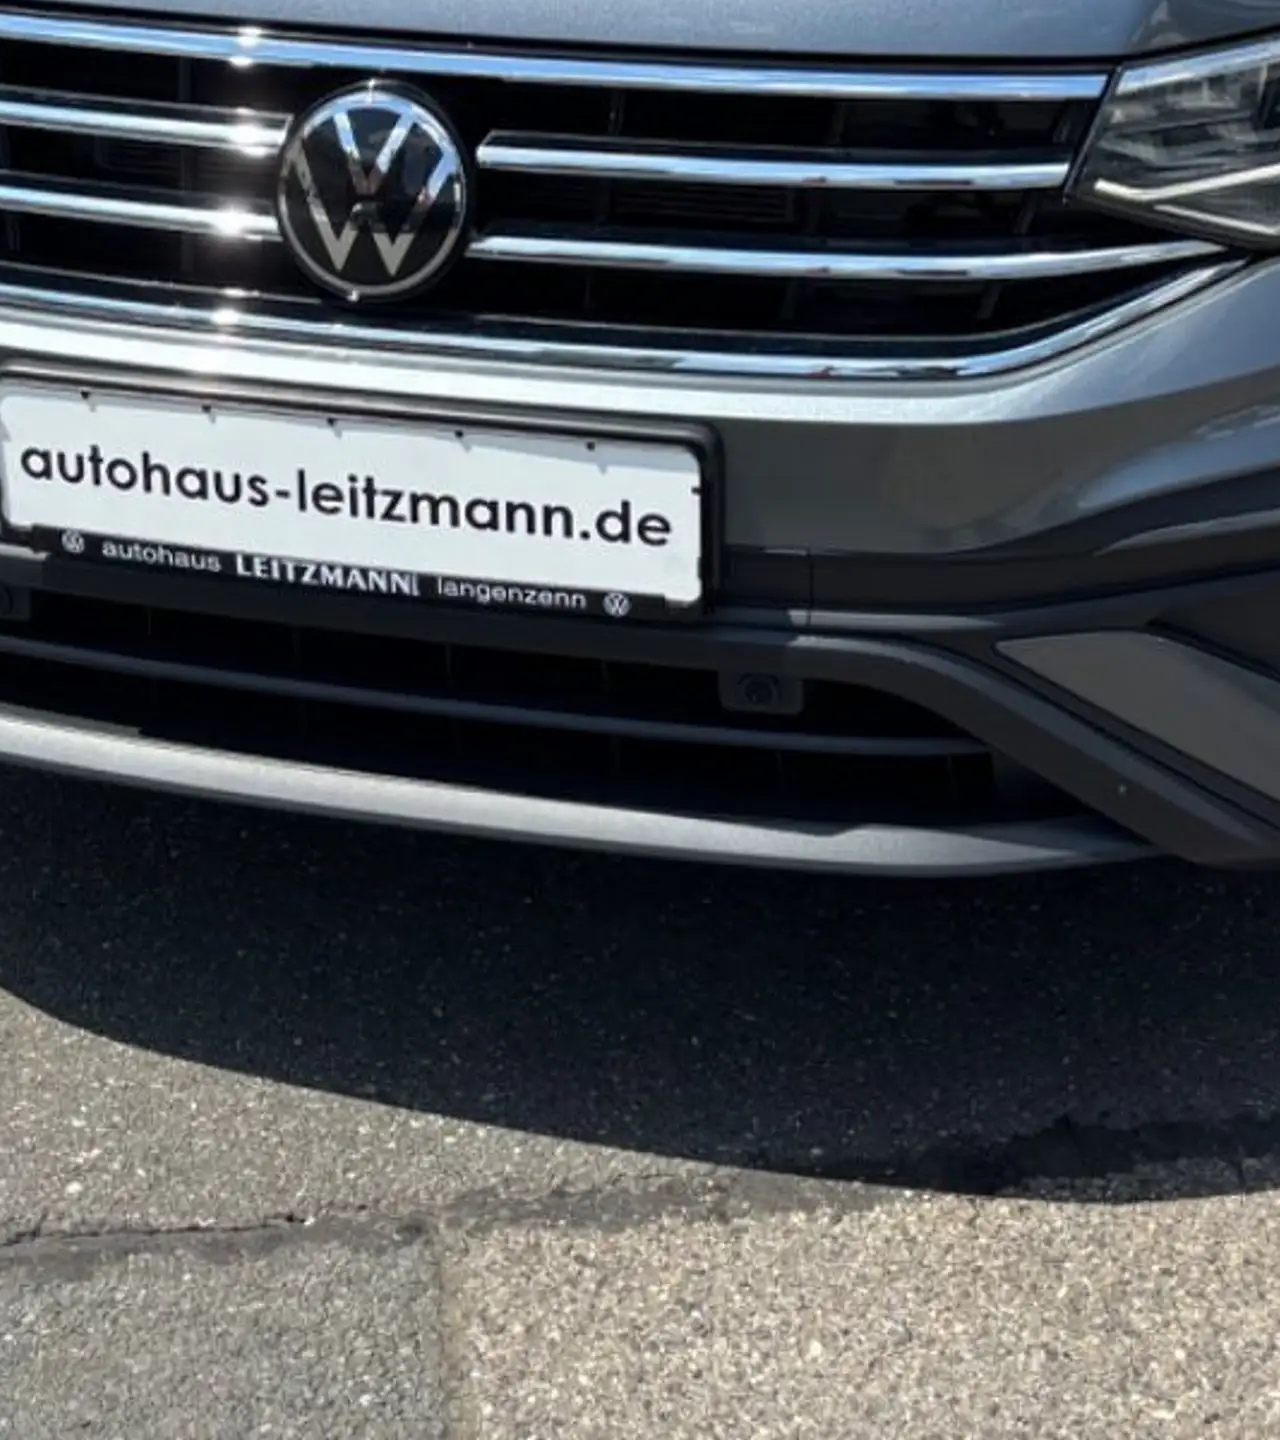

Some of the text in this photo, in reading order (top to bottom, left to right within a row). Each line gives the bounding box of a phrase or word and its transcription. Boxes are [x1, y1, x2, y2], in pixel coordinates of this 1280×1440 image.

[284, 103, 458, 280] VW
[20, 444, 672, 547] autohaus-leitzmann.de
[101, 539, 222, 573] autohaus
[437, 575, 588, 604] langenzenn
